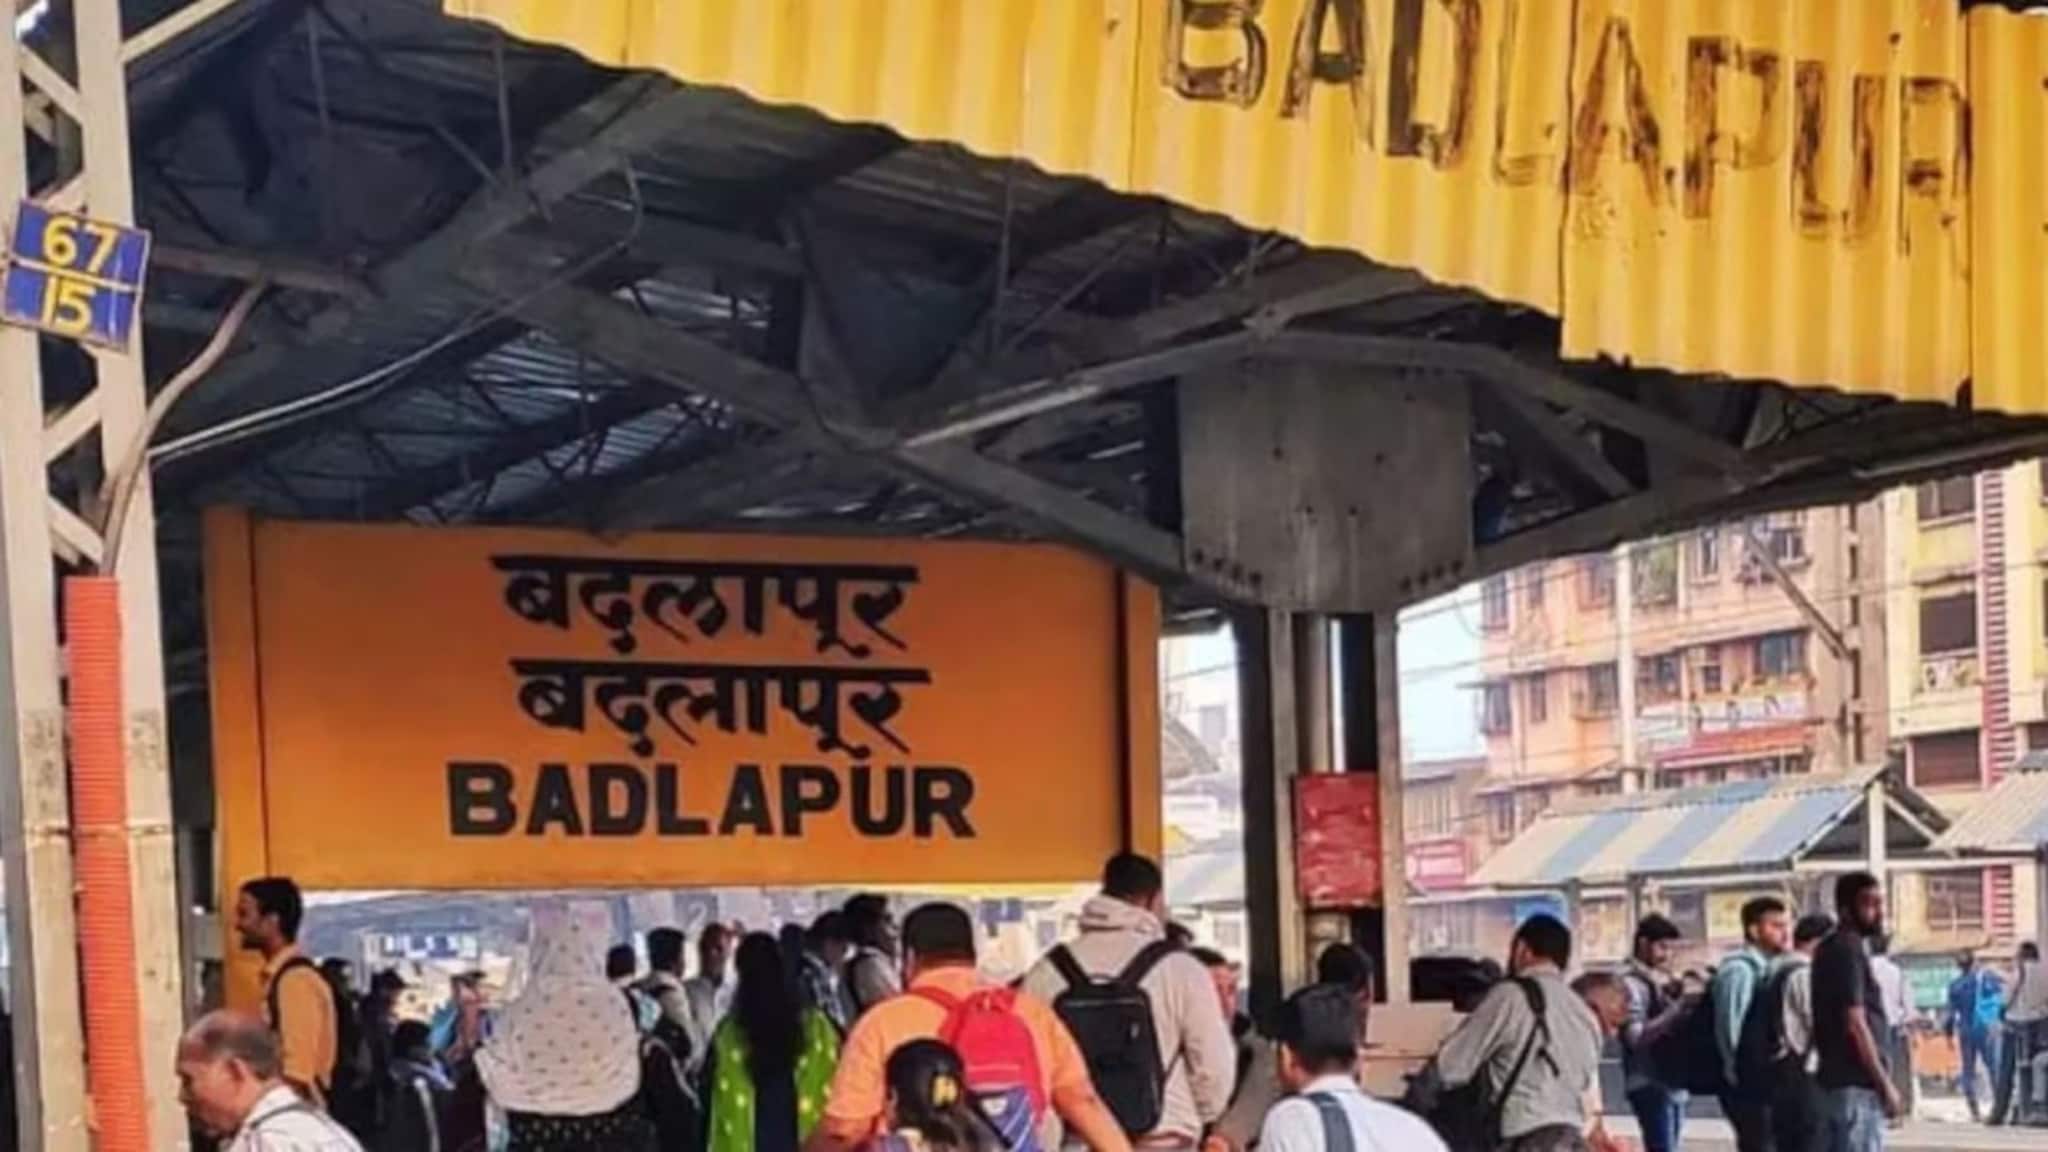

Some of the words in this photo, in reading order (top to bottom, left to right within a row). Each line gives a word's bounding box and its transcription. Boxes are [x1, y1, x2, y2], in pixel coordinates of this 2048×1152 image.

[1161, 0, 1972, 258] BADLAPUR
[44, 215, 118, 272] 67
[42, 275, 96, 333] 15
[490, 555, 919, 657] बदलापूर
[509, 659, 931, 759] बदलापूर
[447, 762, 976, 838] BADLAPUR
